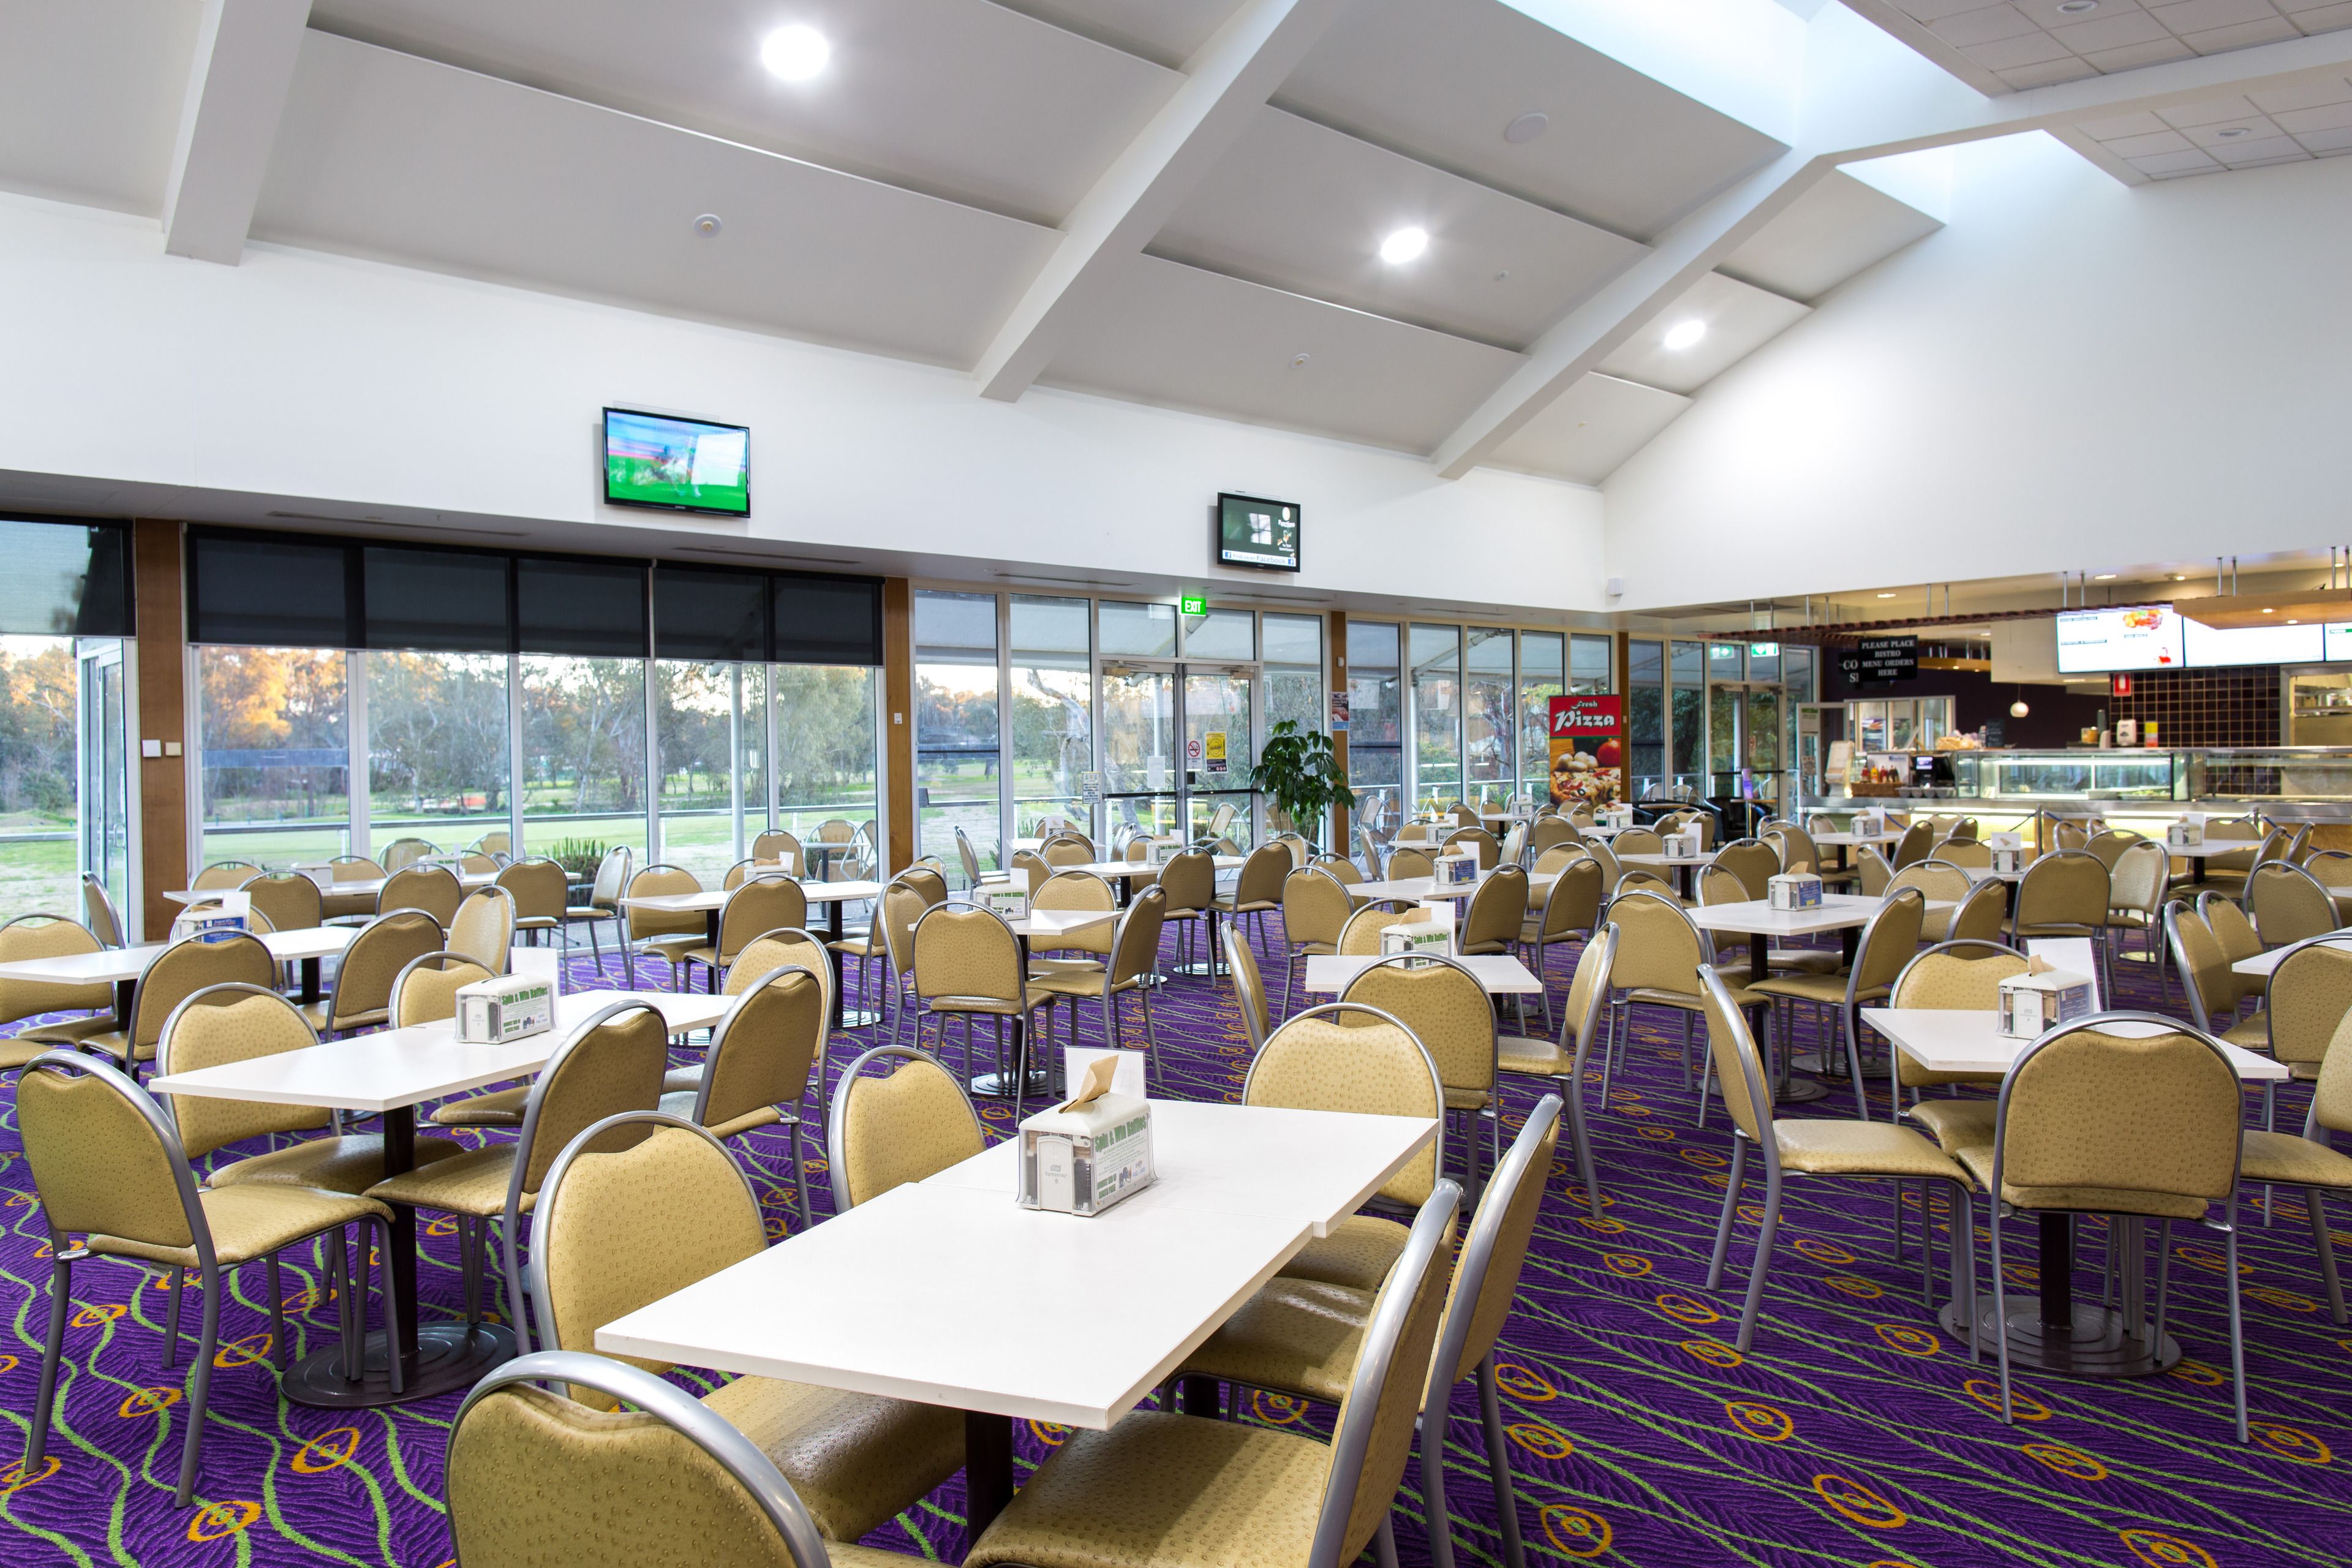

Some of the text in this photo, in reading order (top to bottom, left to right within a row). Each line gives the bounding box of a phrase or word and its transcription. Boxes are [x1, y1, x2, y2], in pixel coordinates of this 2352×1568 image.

[1256, 556, 1286, 564] Facebook
[1185, 600, 1202, 612] EXIT
[1891, 639, 1915, 648] PLACE
[1571, 701, 1597, 709] Fresh
[1555, 710, 1615, 733] Pizza
[502, 987, 548, 1006] Spin & Win Raffles
[1095, 1115, 1147, 1153] Spin & Win Raffles
